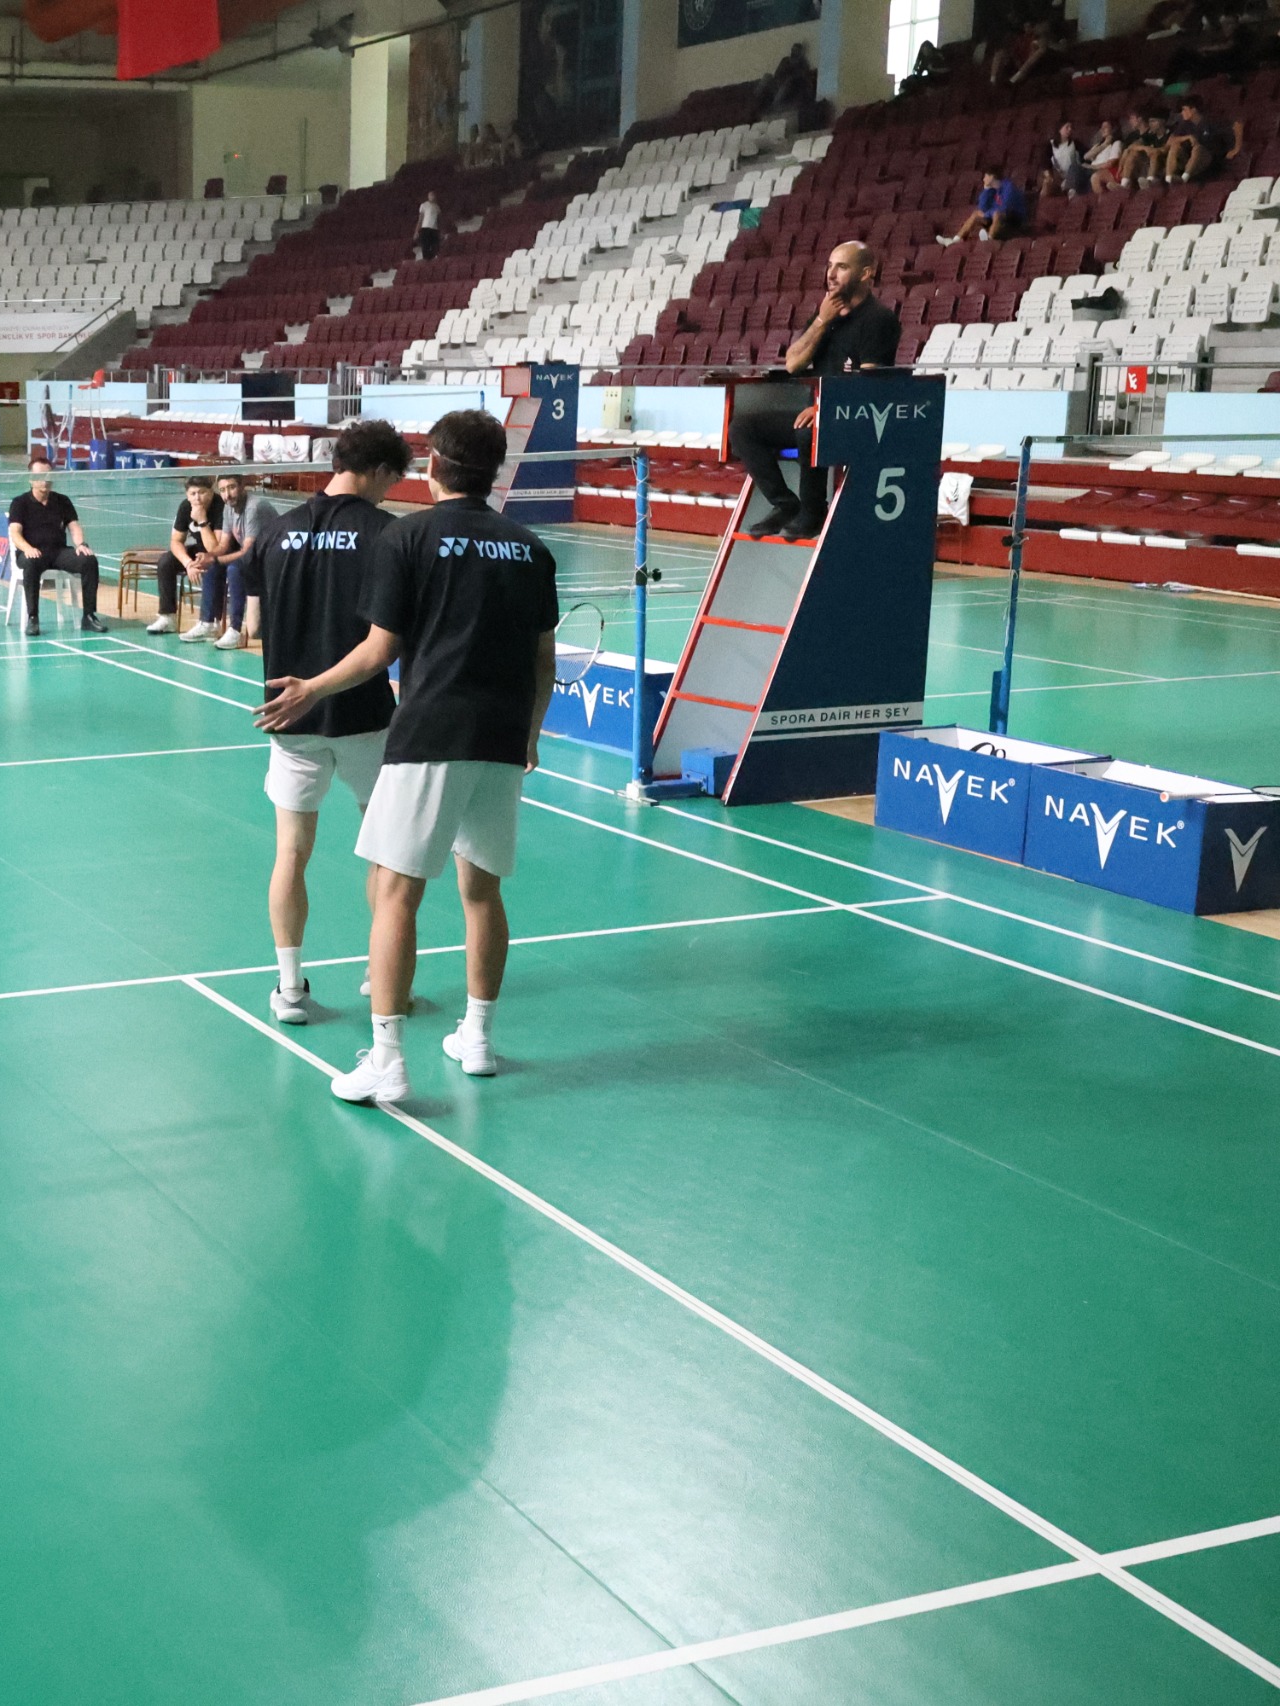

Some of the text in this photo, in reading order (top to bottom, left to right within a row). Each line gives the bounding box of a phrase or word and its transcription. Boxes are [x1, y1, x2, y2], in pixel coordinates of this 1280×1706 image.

[23, 332, 34, 340] VE
[551, 399, 565, 420] 3
[874, 467, 906, 522] 5
[310, 531, 359, 550] YONEX
[472, 538, 533, 563] YONEX
[770, 707, 910, 725] SPORA DAİR HER ŞEY
